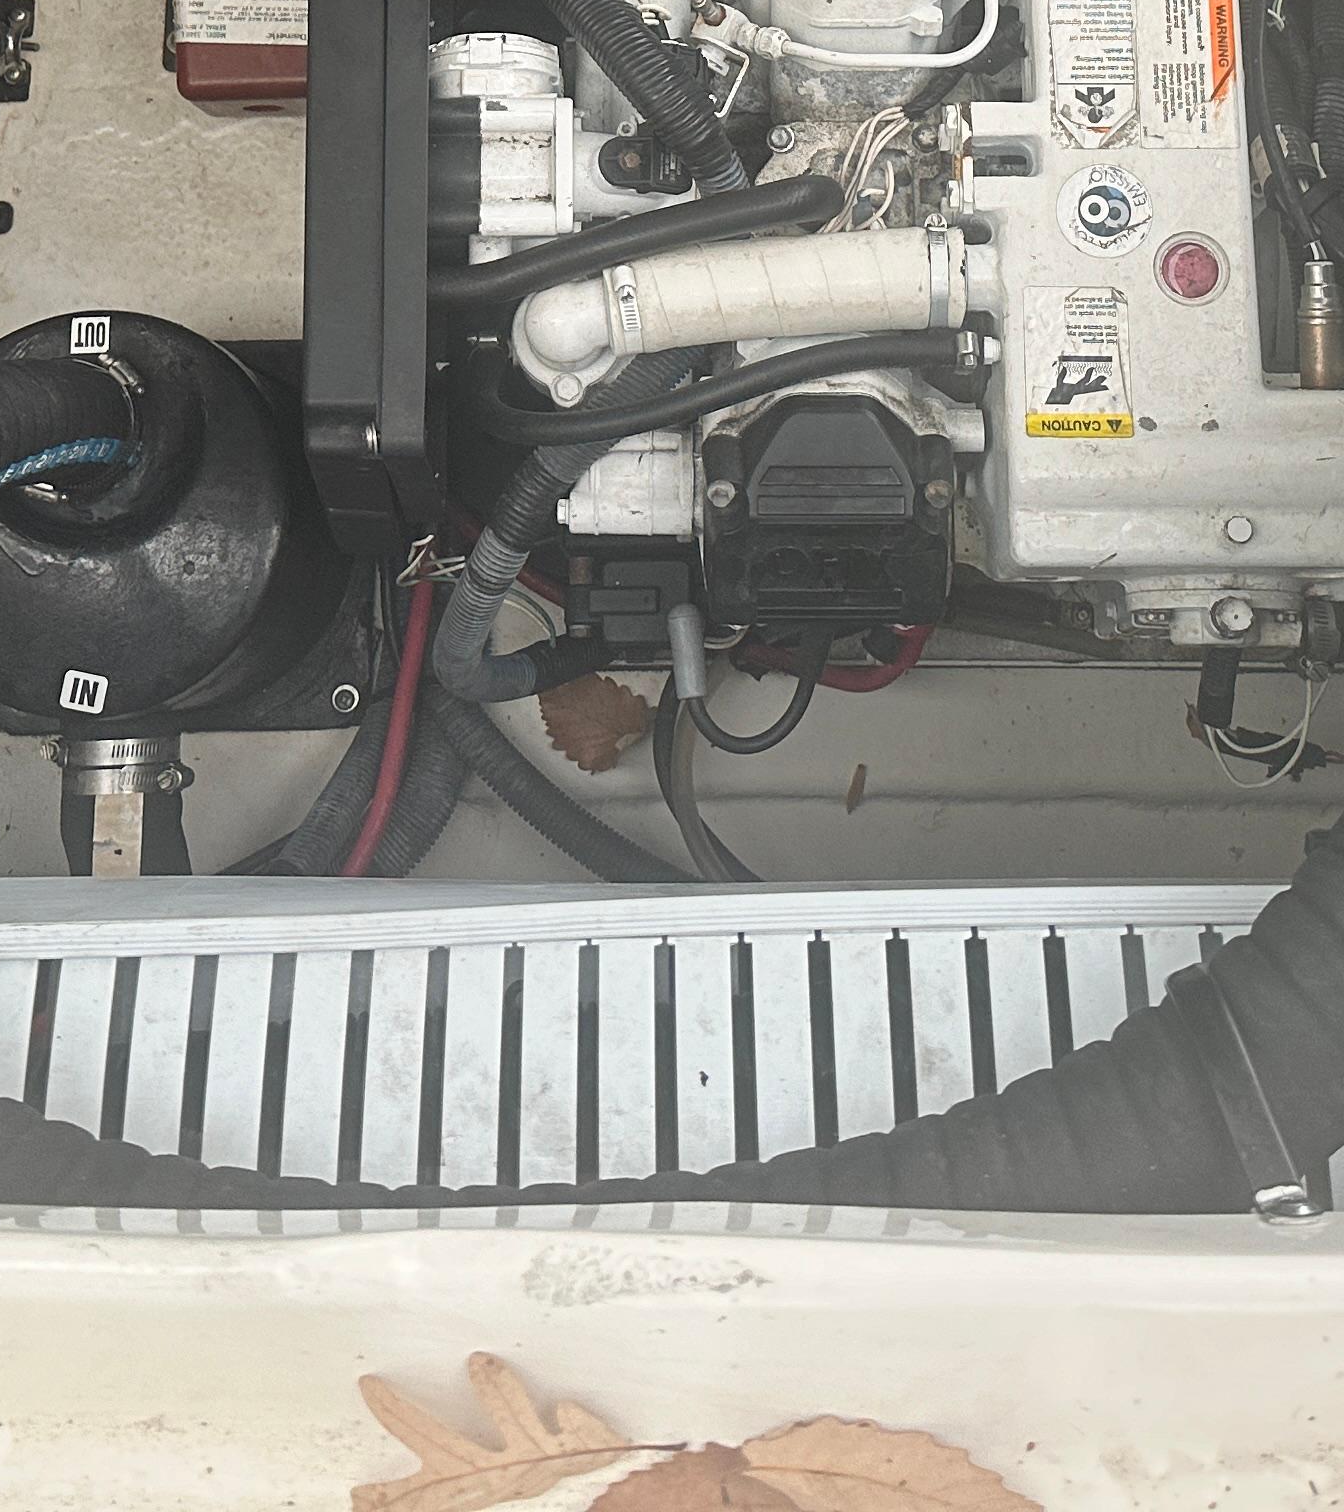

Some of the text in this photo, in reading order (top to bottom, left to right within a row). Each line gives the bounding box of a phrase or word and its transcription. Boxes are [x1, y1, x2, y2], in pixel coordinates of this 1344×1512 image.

[1215, 4, 1228, 68] WARNING
[74, 322, 105, 347] OUT
[1041, 420, 1101, 431] CAUTION
[69, 678, 99, 707] IN
